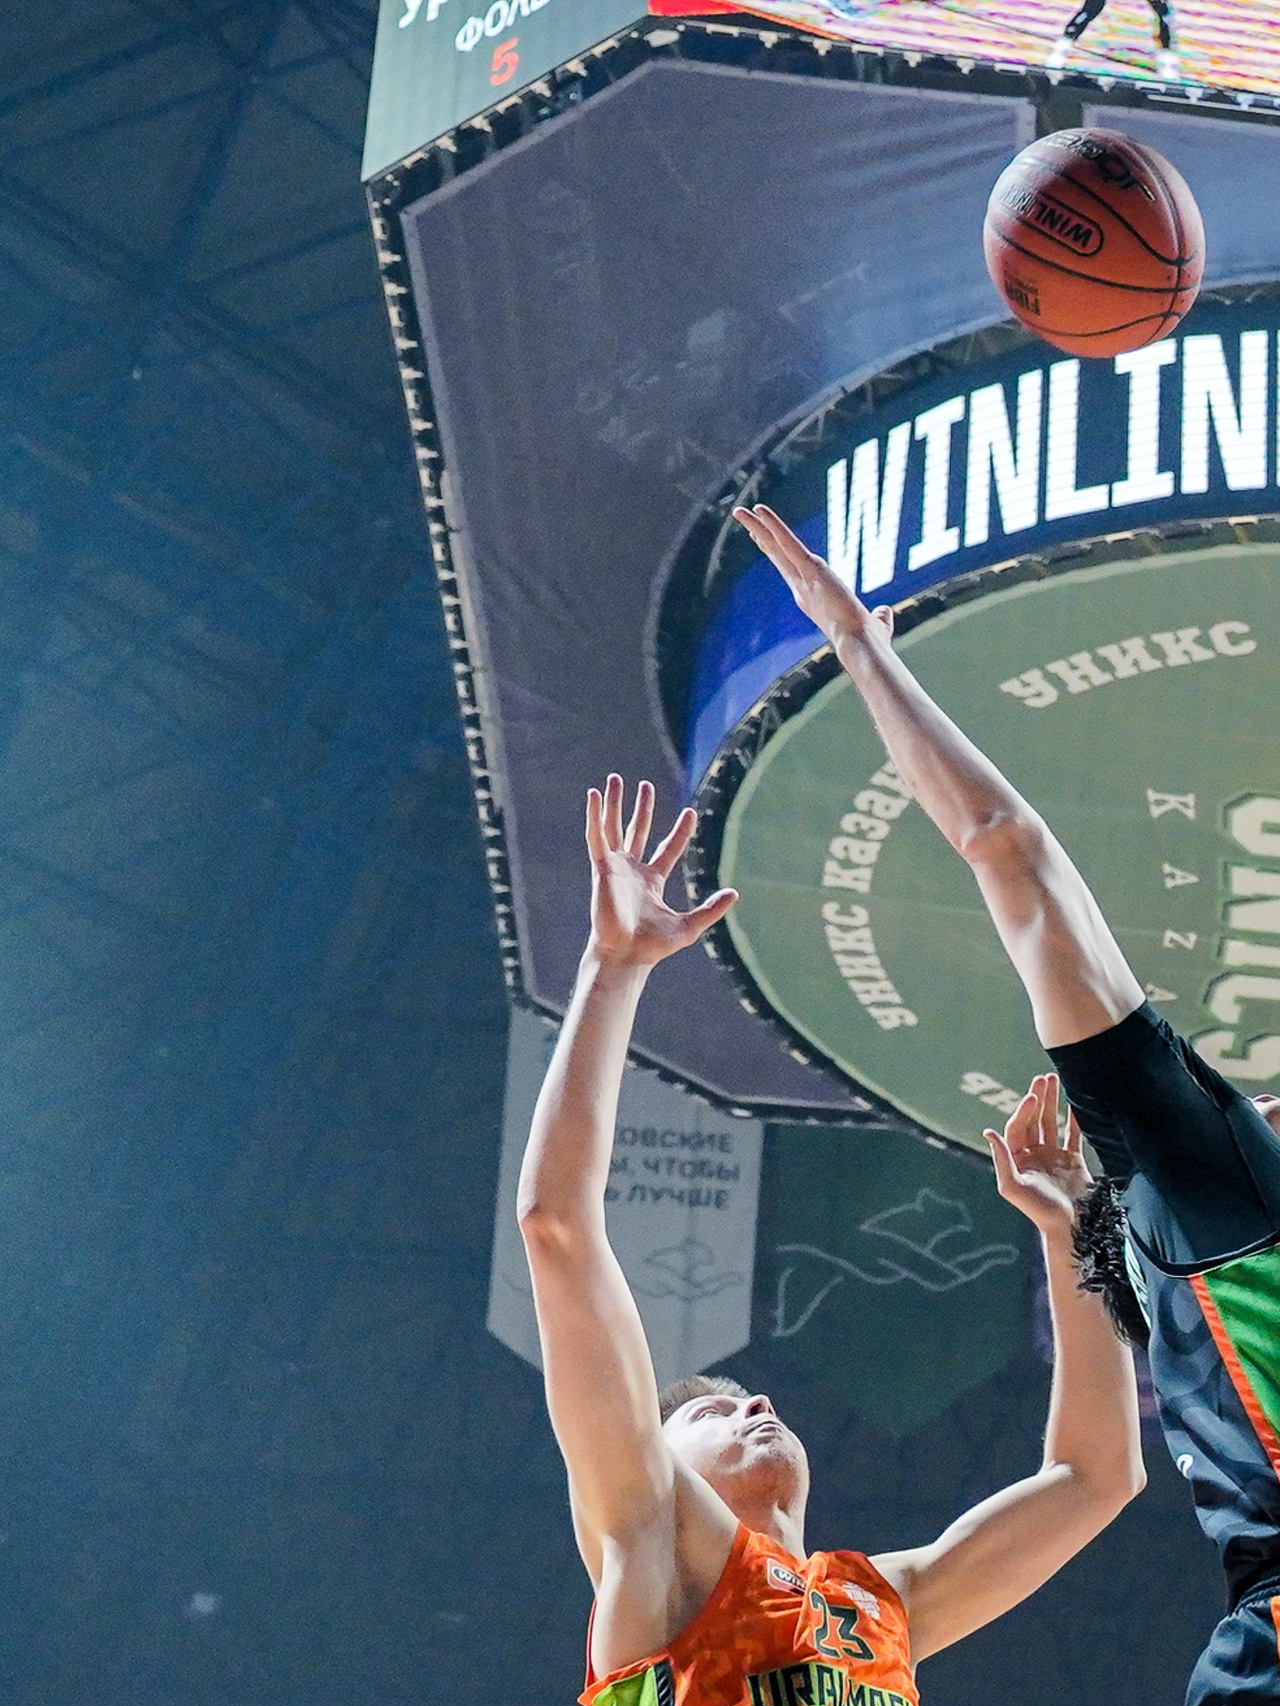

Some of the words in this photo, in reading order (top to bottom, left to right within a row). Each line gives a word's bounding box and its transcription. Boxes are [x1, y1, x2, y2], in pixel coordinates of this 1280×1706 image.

[455, 0, 549, 51] ФОЛ
[490, 37, 520, 86] 5
[809, 1589, 877, 1662] 23
